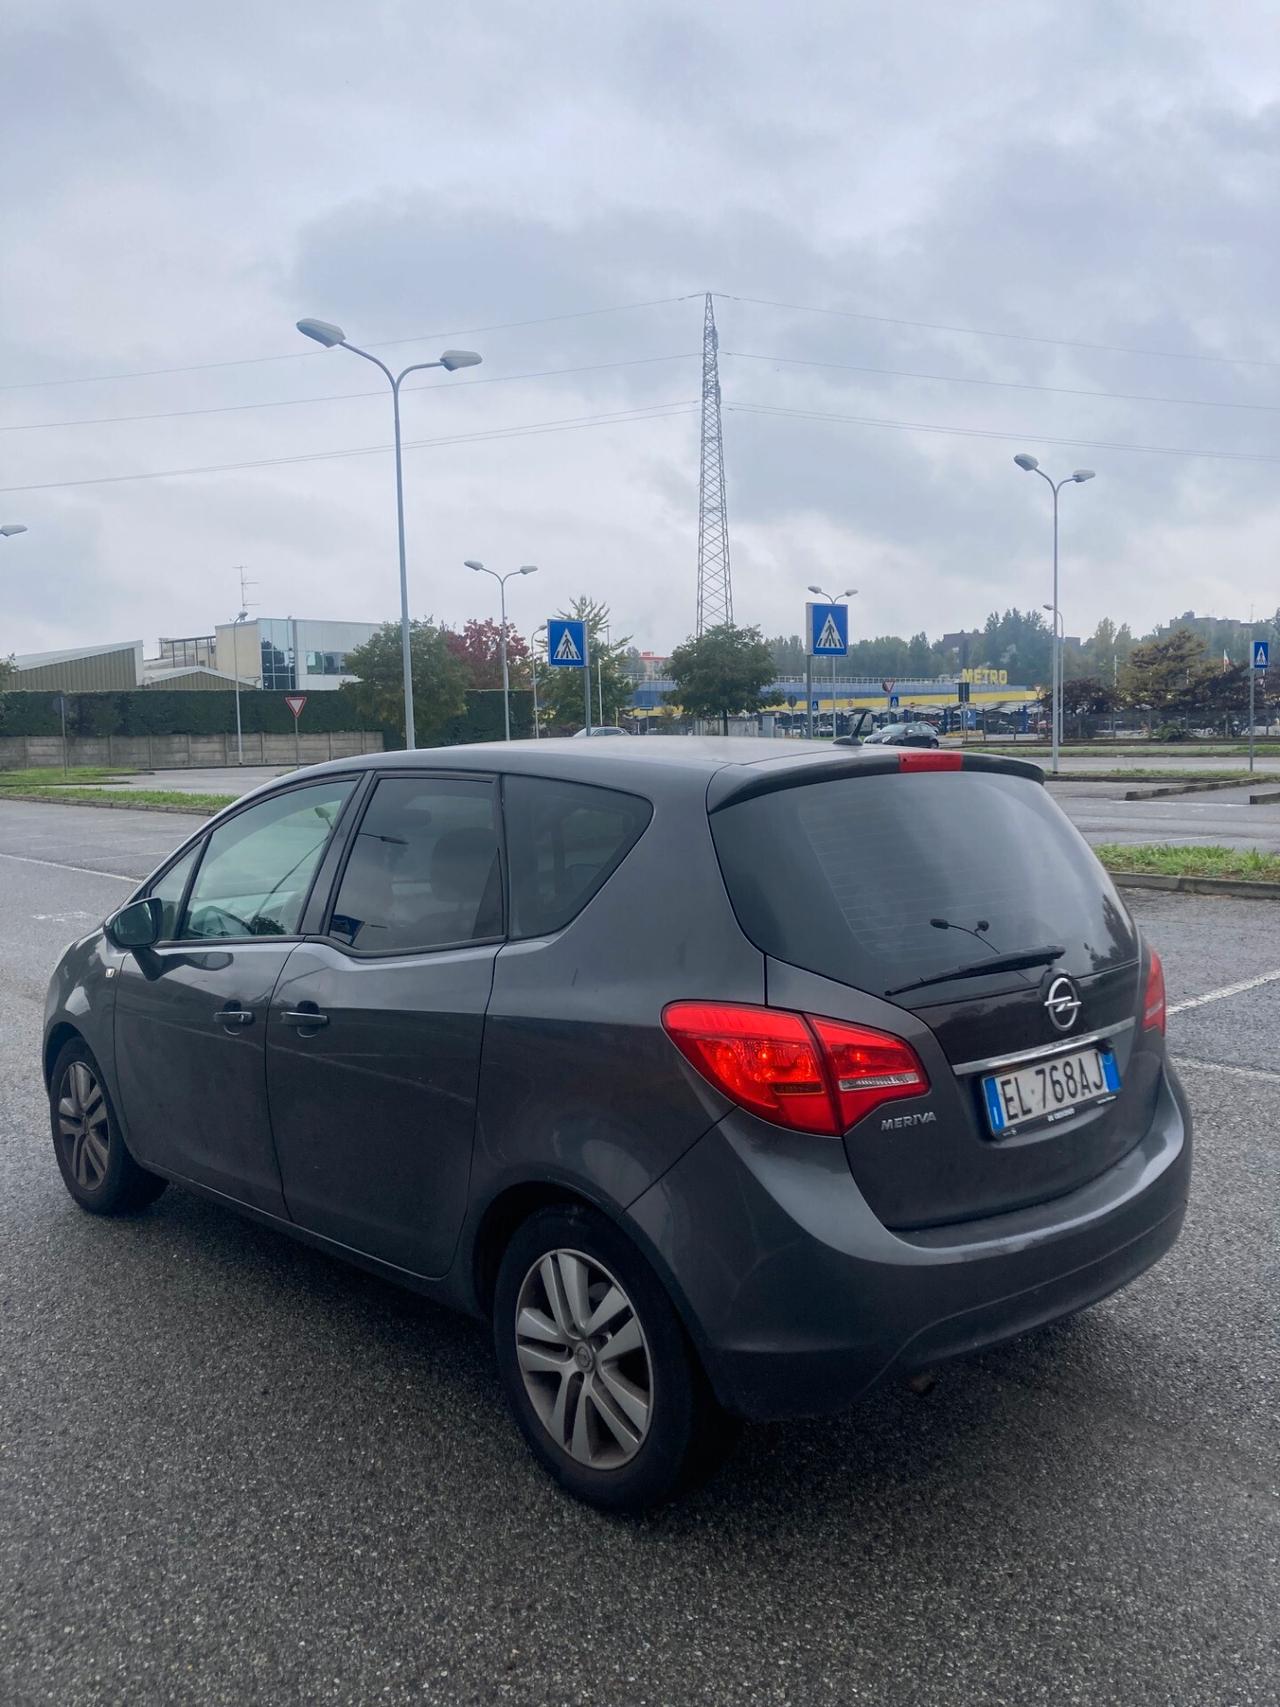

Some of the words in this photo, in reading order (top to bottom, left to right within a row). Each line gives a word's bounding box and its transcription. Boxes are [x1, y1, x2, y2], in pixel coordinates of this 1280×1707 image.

[962, 668, 1008, 685] METRO
[1000, 1077, 1033, 1121] EL
[1035, 1052, 1104, 1109] 768AJ
[881, 1111, 937, 1131] MERIVA
